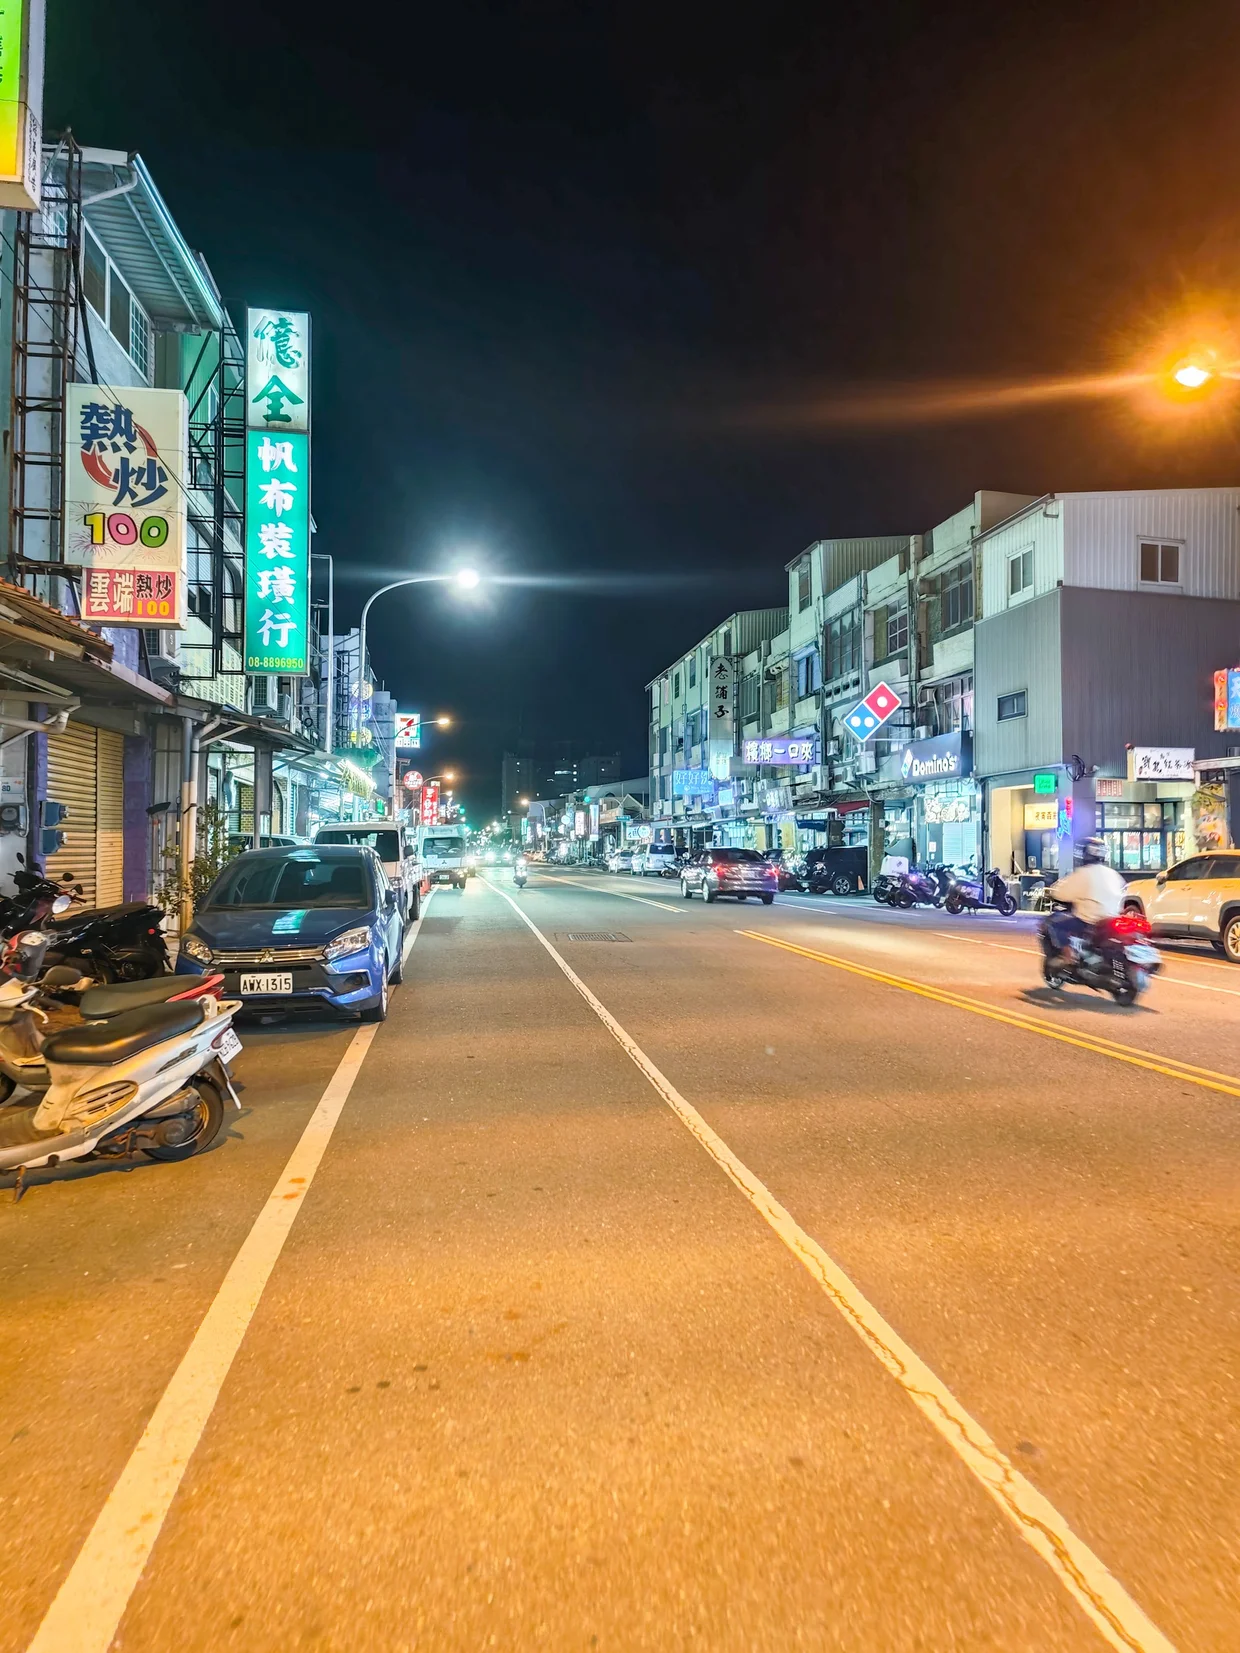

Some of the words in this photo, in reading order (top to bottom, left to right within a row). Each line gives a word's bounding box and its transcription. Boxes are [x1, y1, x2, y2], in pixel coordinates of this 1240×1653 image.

[80, 402, 169, 508] 熱炒
[84, 512, 169, 549] 100
[256, 436, 299, 648] 帆布裝璜行
[90, 572, 134, 614] 雲端
[136, 574, 172, 600] 熱炒
[137, 600, 170, 616] 100
[248, 656, 304, 669] 08-8896950
[746, 741, 813, 762] 檳榔一口來
[912, 752, 956, 777] Domino's
[242, 977, 292, 992] AWX-1315
